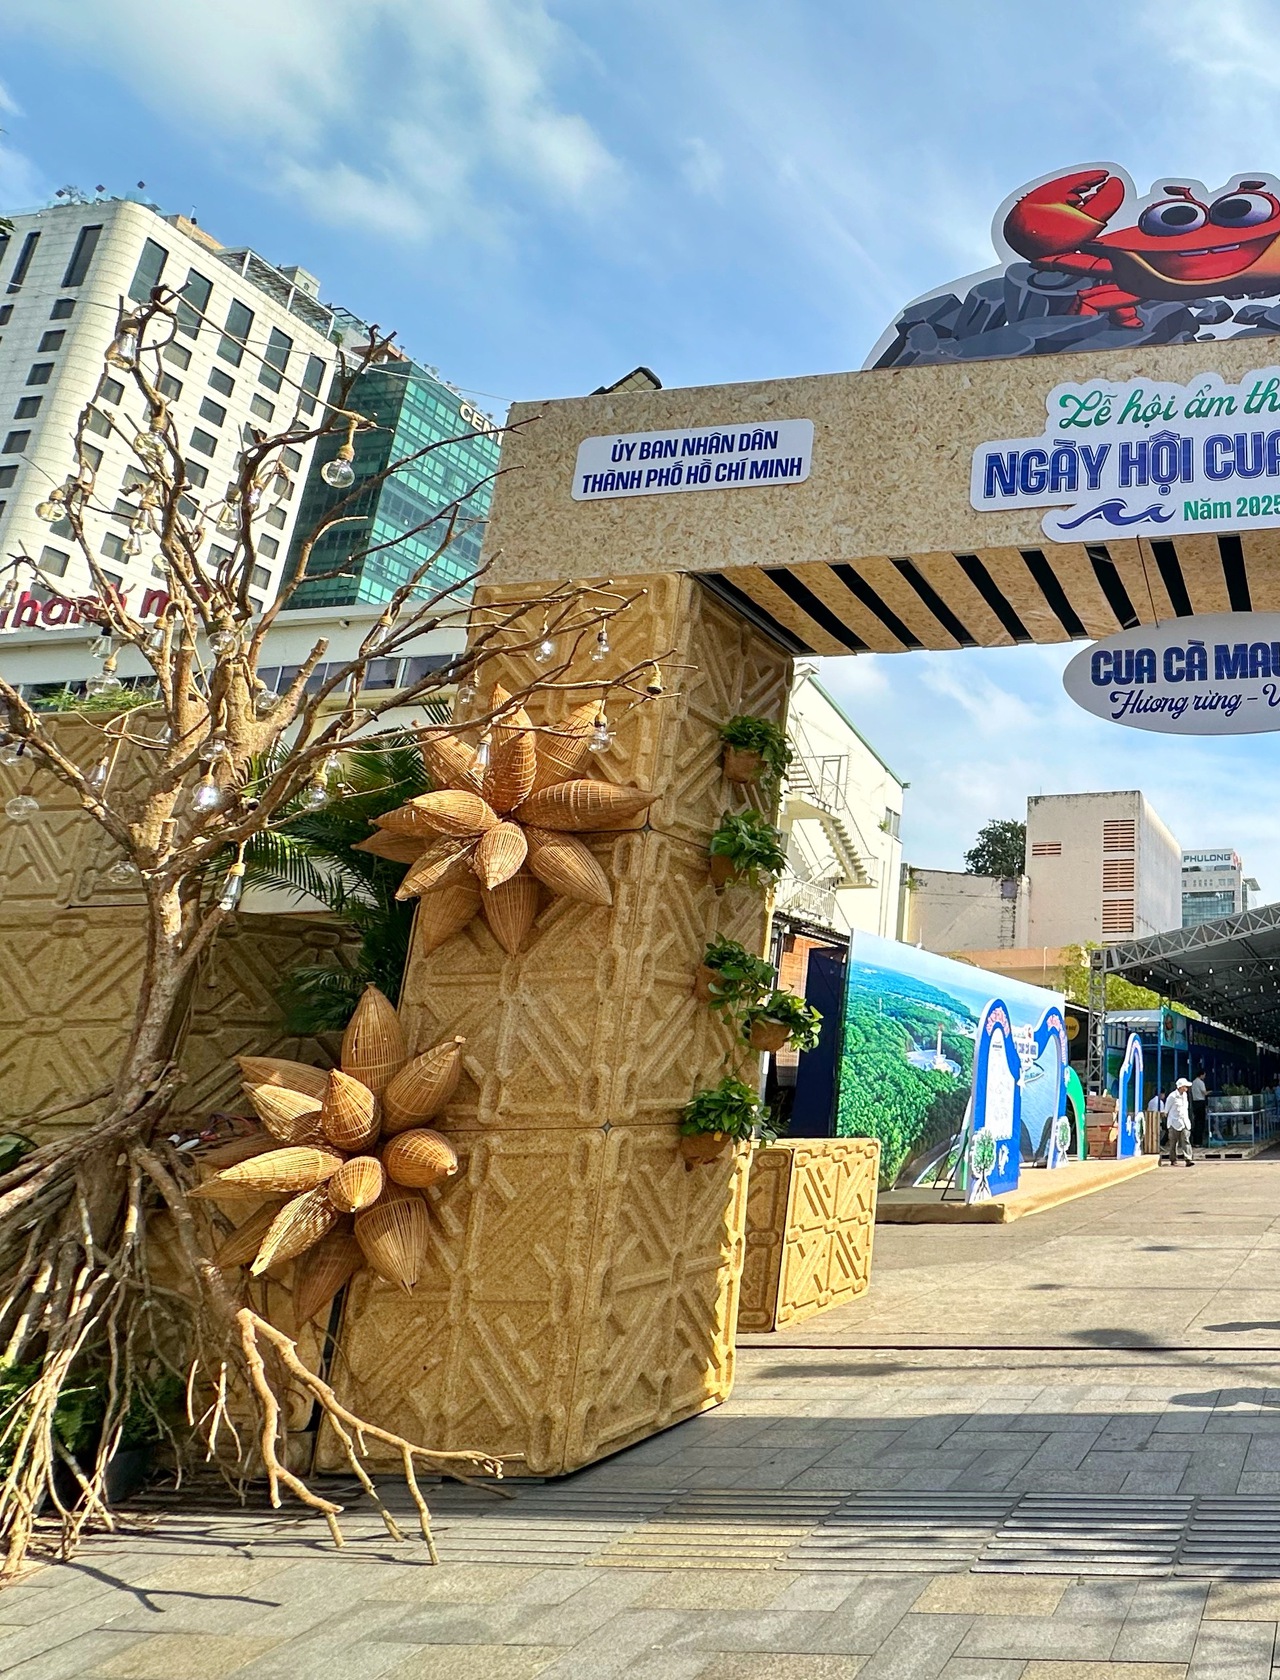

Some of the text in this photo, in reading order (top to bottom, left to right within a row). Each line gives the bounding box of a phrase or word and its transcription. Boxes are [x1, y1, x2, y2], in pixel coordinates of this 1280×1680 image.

[1059, 390, 1118, 429] Lễ
[1117, 389, 1179, 428] hội
[1184, 384, 1238, 419] ẩm
[611, 428, 778, 463] ỦY BAN NHÂN DÂN
[582, 457, 802, 493] THÀNH PHỐ HỒ CHÍ MINH
[983, 439, 1112, 498] NGÀY
[1118, 429, 1194, 496] HỘI
[1184, 497, 1232, 521] Năm
[1091, 648, 1157, 686] CUA
[1163, 639, 1208, 683] CÀ
[1109, 689, 1188, 719] Hương
[1193, 689, 1242, 717] rừng
[1183, 854, 1231, 862] PHULONG
